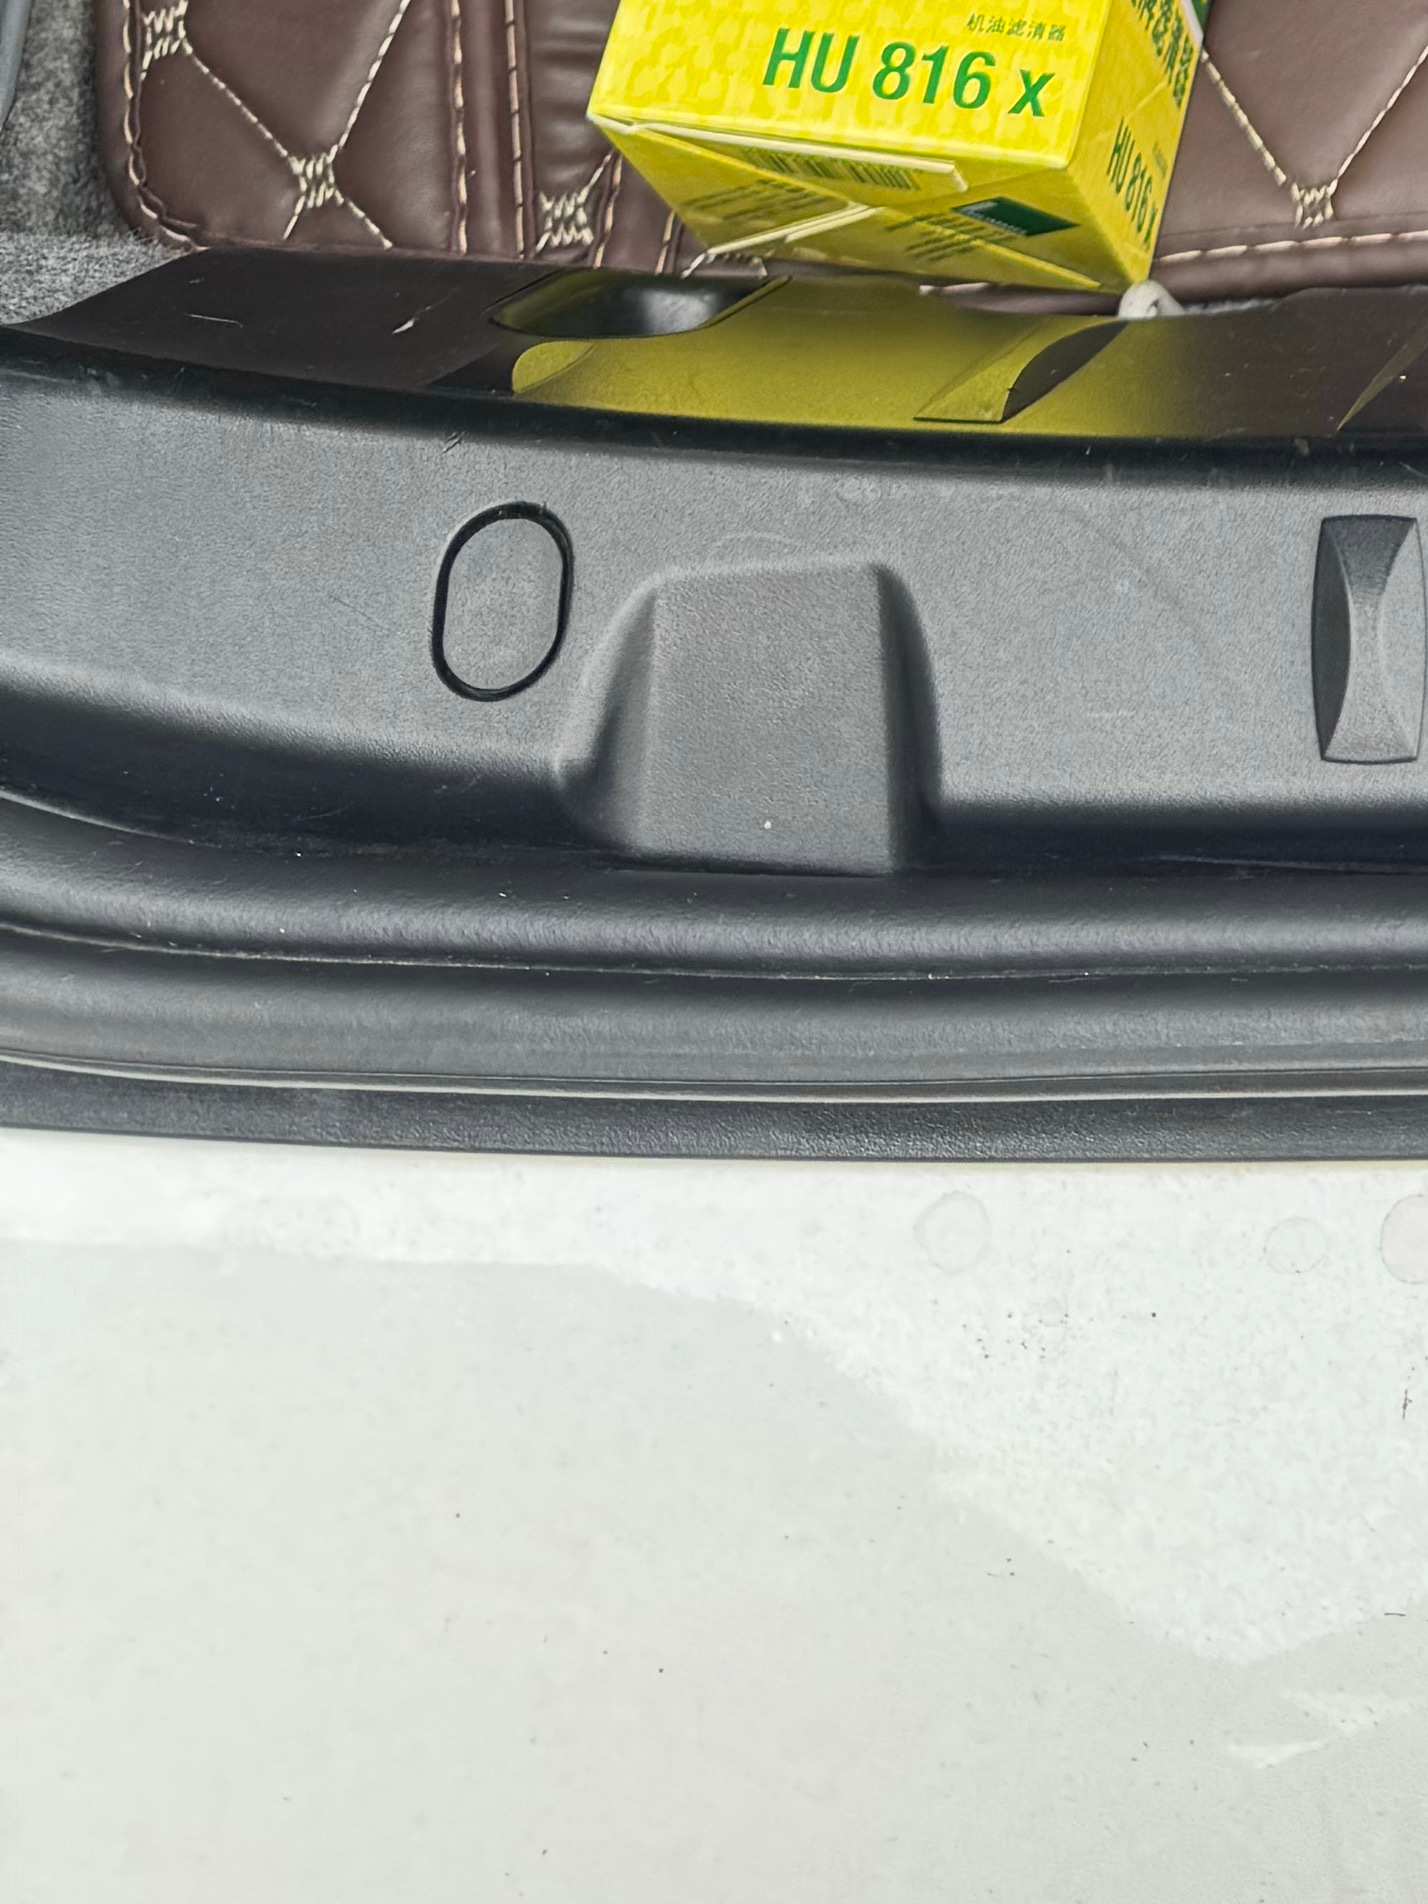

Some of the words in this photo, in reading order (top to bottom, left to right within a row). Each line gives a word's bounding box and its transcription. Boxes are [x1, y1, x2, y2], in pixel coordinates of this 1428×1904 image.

[762, 28, 860, 94] HU
[871, 40, 997, 110] 816
[1106, 117, 1136, 196] HU
